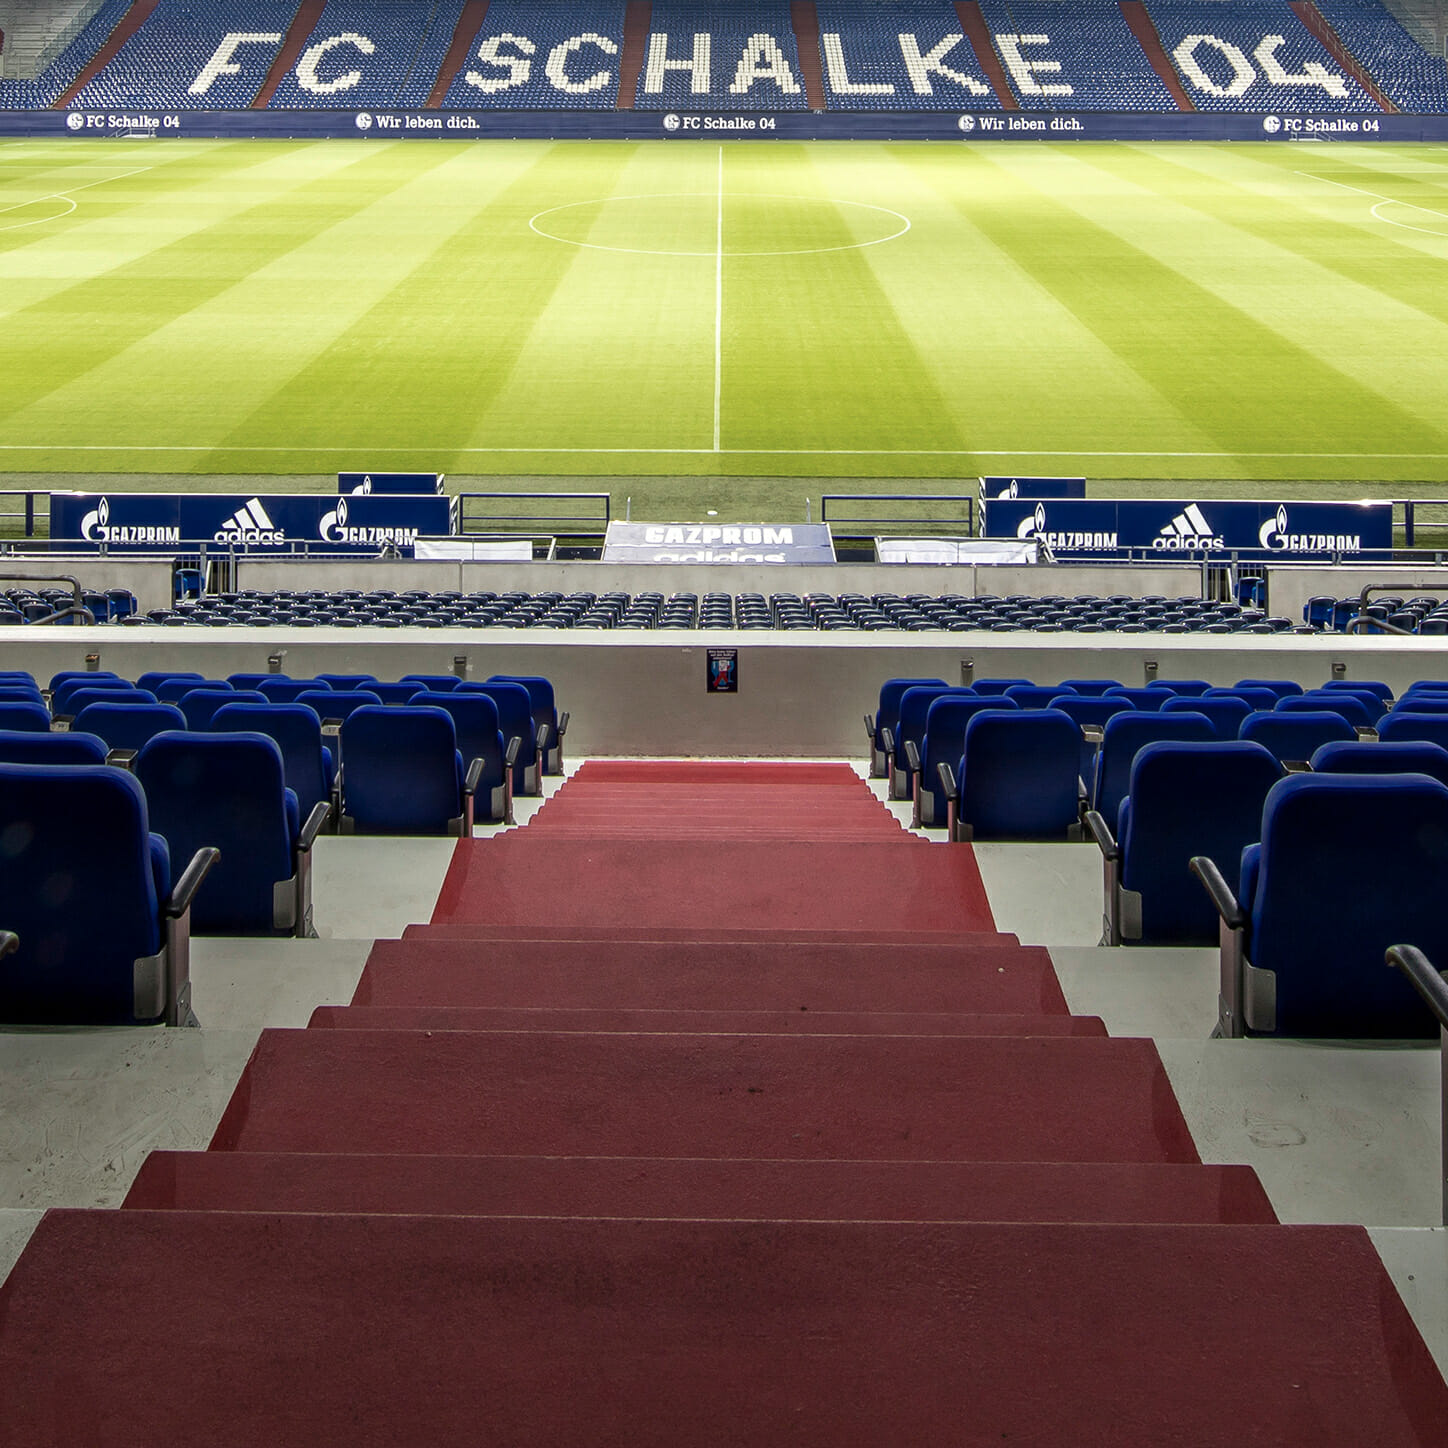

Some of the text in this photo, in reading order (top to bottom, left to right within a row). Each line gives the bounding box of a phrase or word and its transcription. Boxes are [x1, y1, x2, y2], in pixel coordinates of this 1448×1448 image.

[188, 33, 1352, 99] FC SCHALKE 04
[86, 115, 180, 128] FC Schalke 04
[376, 115, 480, 129] Wir leben dich.
[683, 116, 776, 129] FC Schalke 04
[979, 117, 1084, 130] Wir leben dich.
[1284, 119, 1380, 132] FC Schalke 04
[110, 526, 180, 545] GAZPROM
[214, 528, 285, 546] adidas
[349, 527, 418, 546] GAZPROM
[645, 527, 793, 545] GAZPROM
[1048, 533, 1118, 551] GAZPROM
[1152, 535, 1225, 552] adidas
[1289, 535, 1360, 553] GAZPROM
